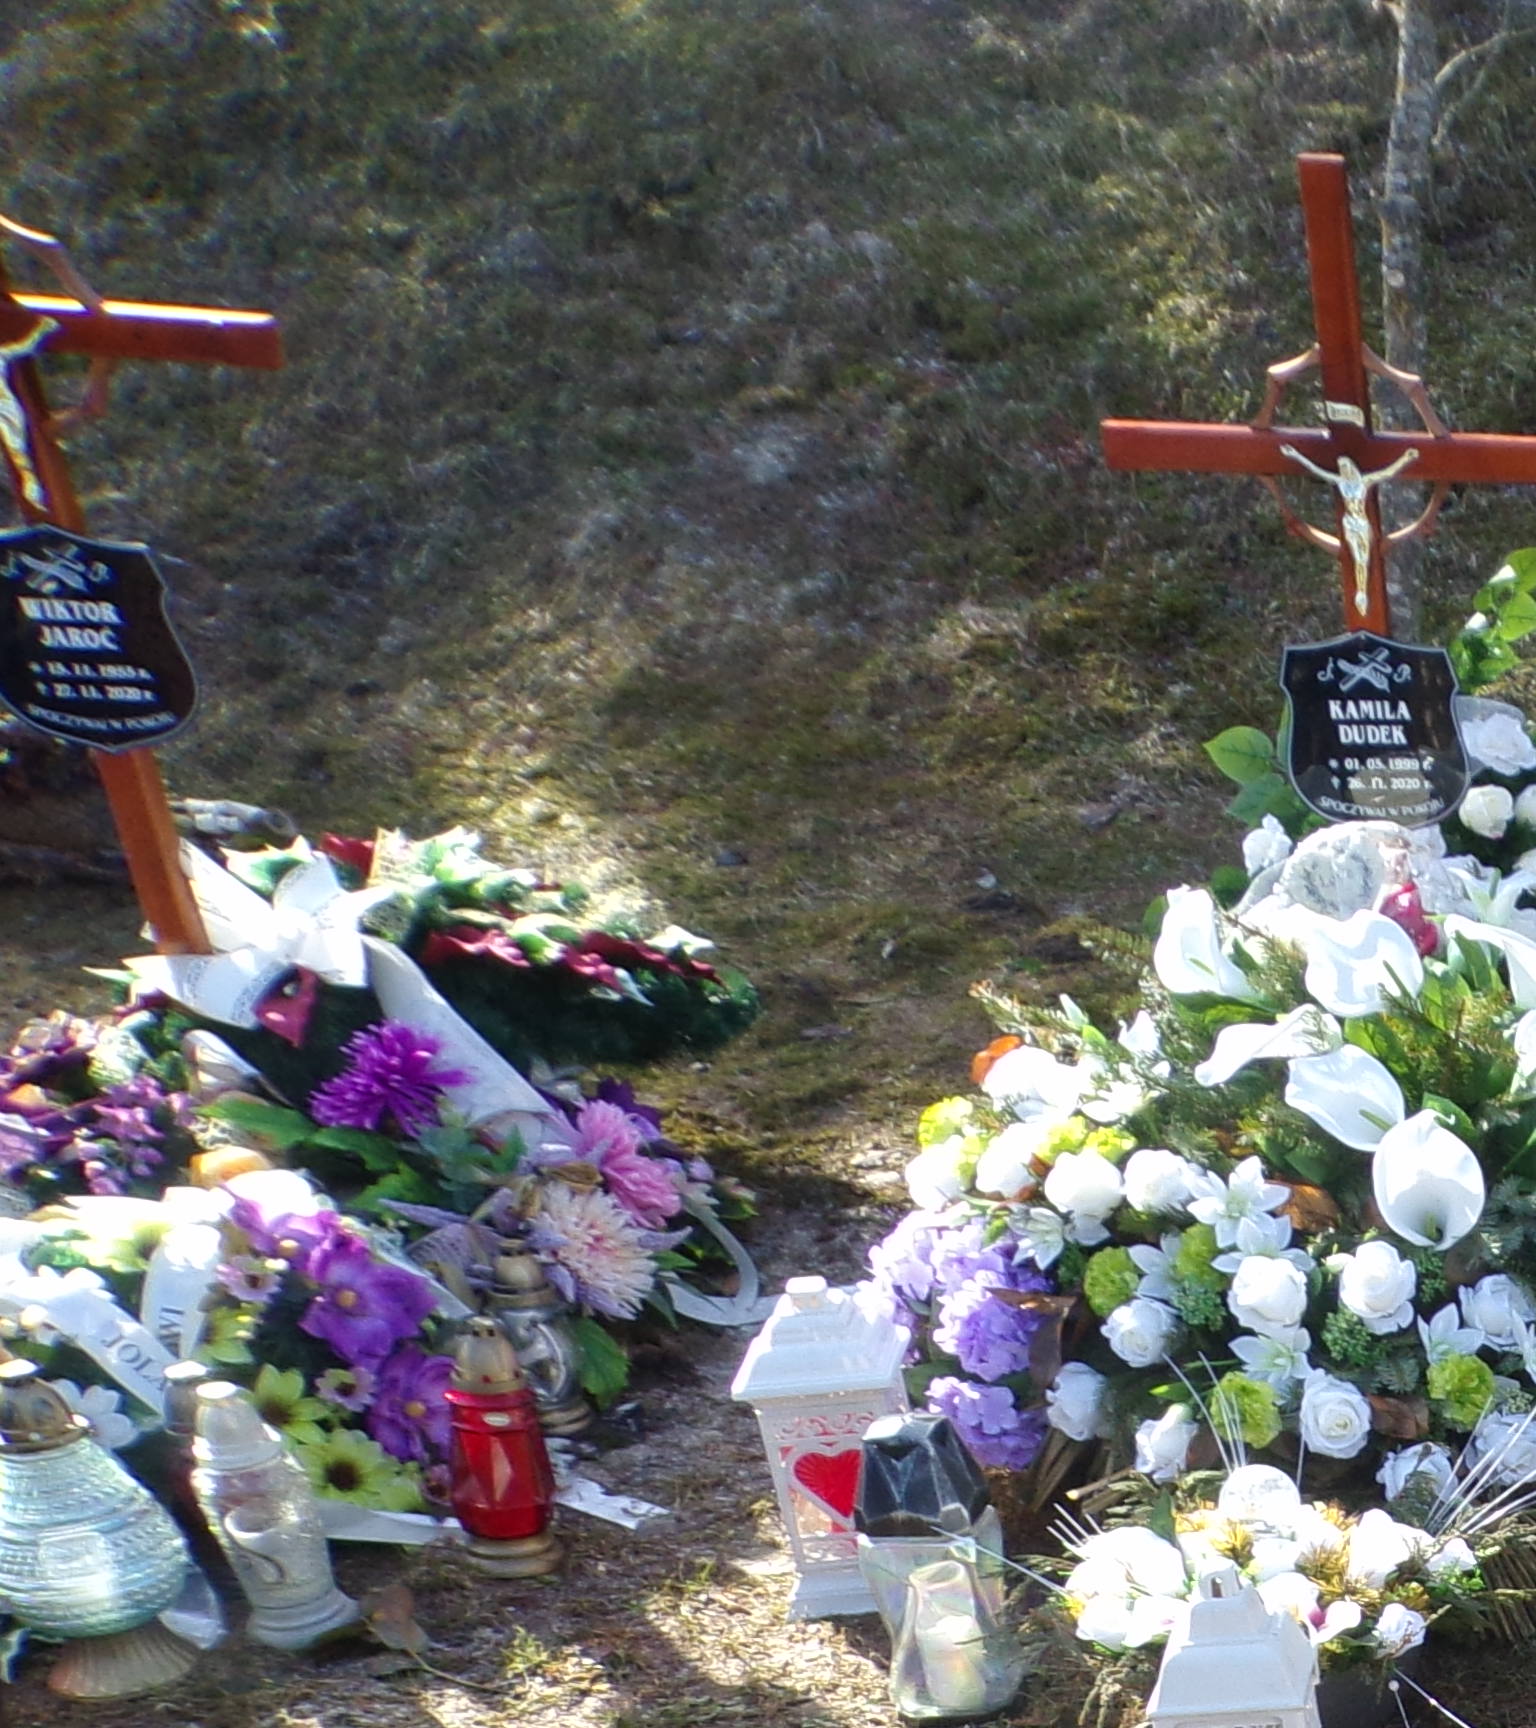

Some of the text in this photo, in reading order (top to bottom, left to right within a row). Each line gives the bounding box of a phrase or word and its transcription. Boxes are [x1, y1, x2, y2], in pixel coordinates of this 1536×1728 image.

[18, 596, 121, 624] WIKTOR
[103, 686, 141, 701] 2020
[1328, 699, 1412, 721] KAMILA
[1338, 725, 1408, 746] DUDEK
[1390, 777, 1421, 791] 2020
[1318, 796, 1387, 818] SPOCZYWAJ
[1390, 807, 1402, 818] W
